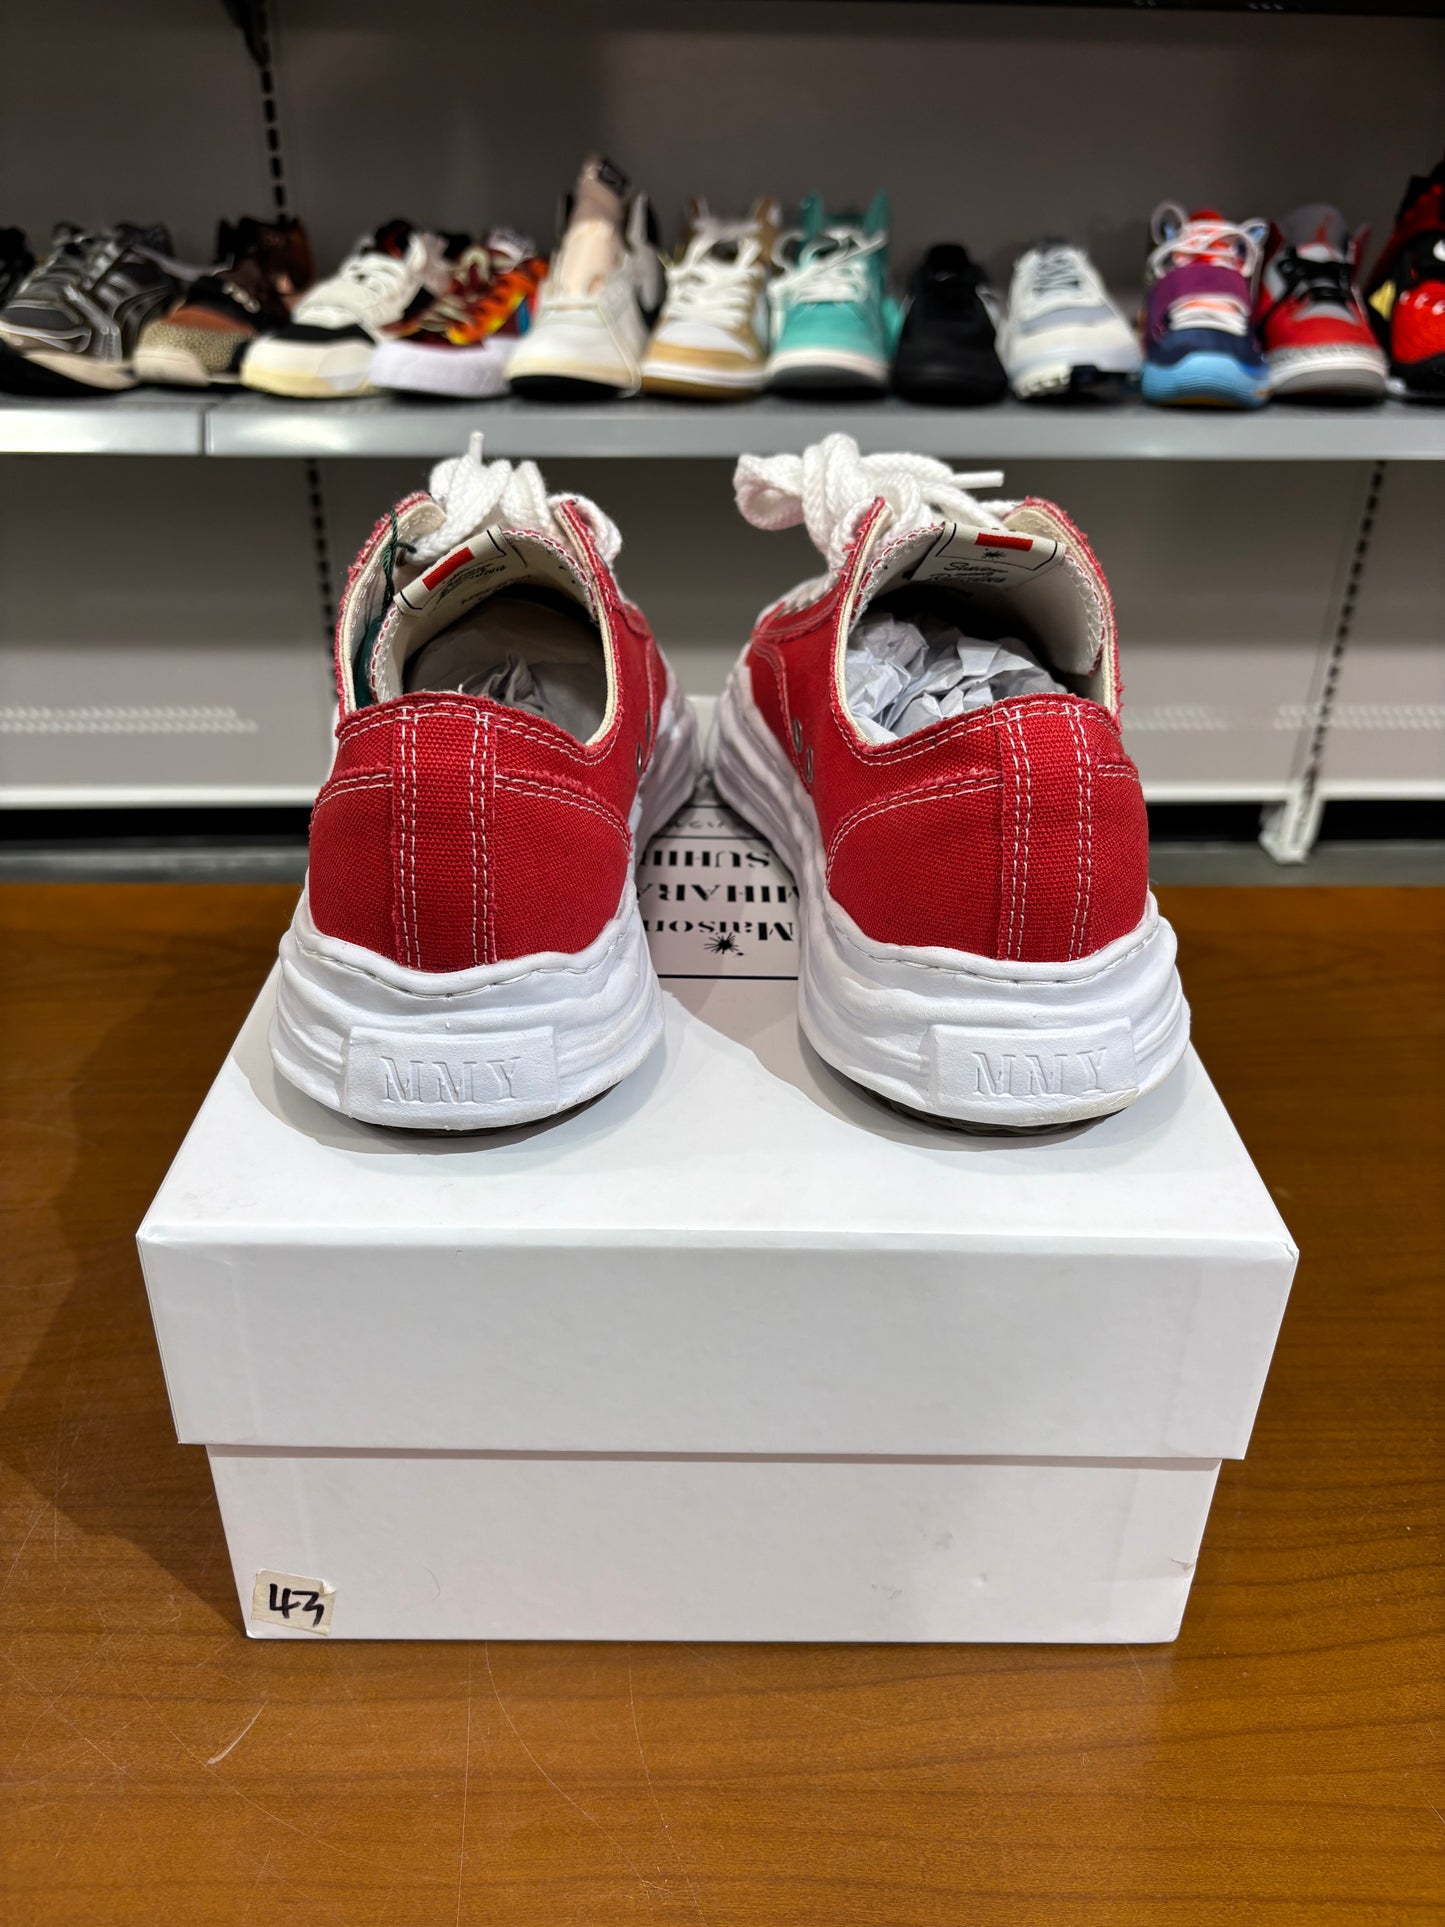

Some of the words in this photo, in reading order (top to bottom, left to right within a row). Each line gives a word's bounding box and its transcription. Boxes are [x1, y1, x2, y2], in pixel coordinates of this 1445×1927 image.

[380, 1056, 521, 1104] MMY
[972, 1047, 1107, 1098] MMY
[269, 1583, 325, 1628] 43
